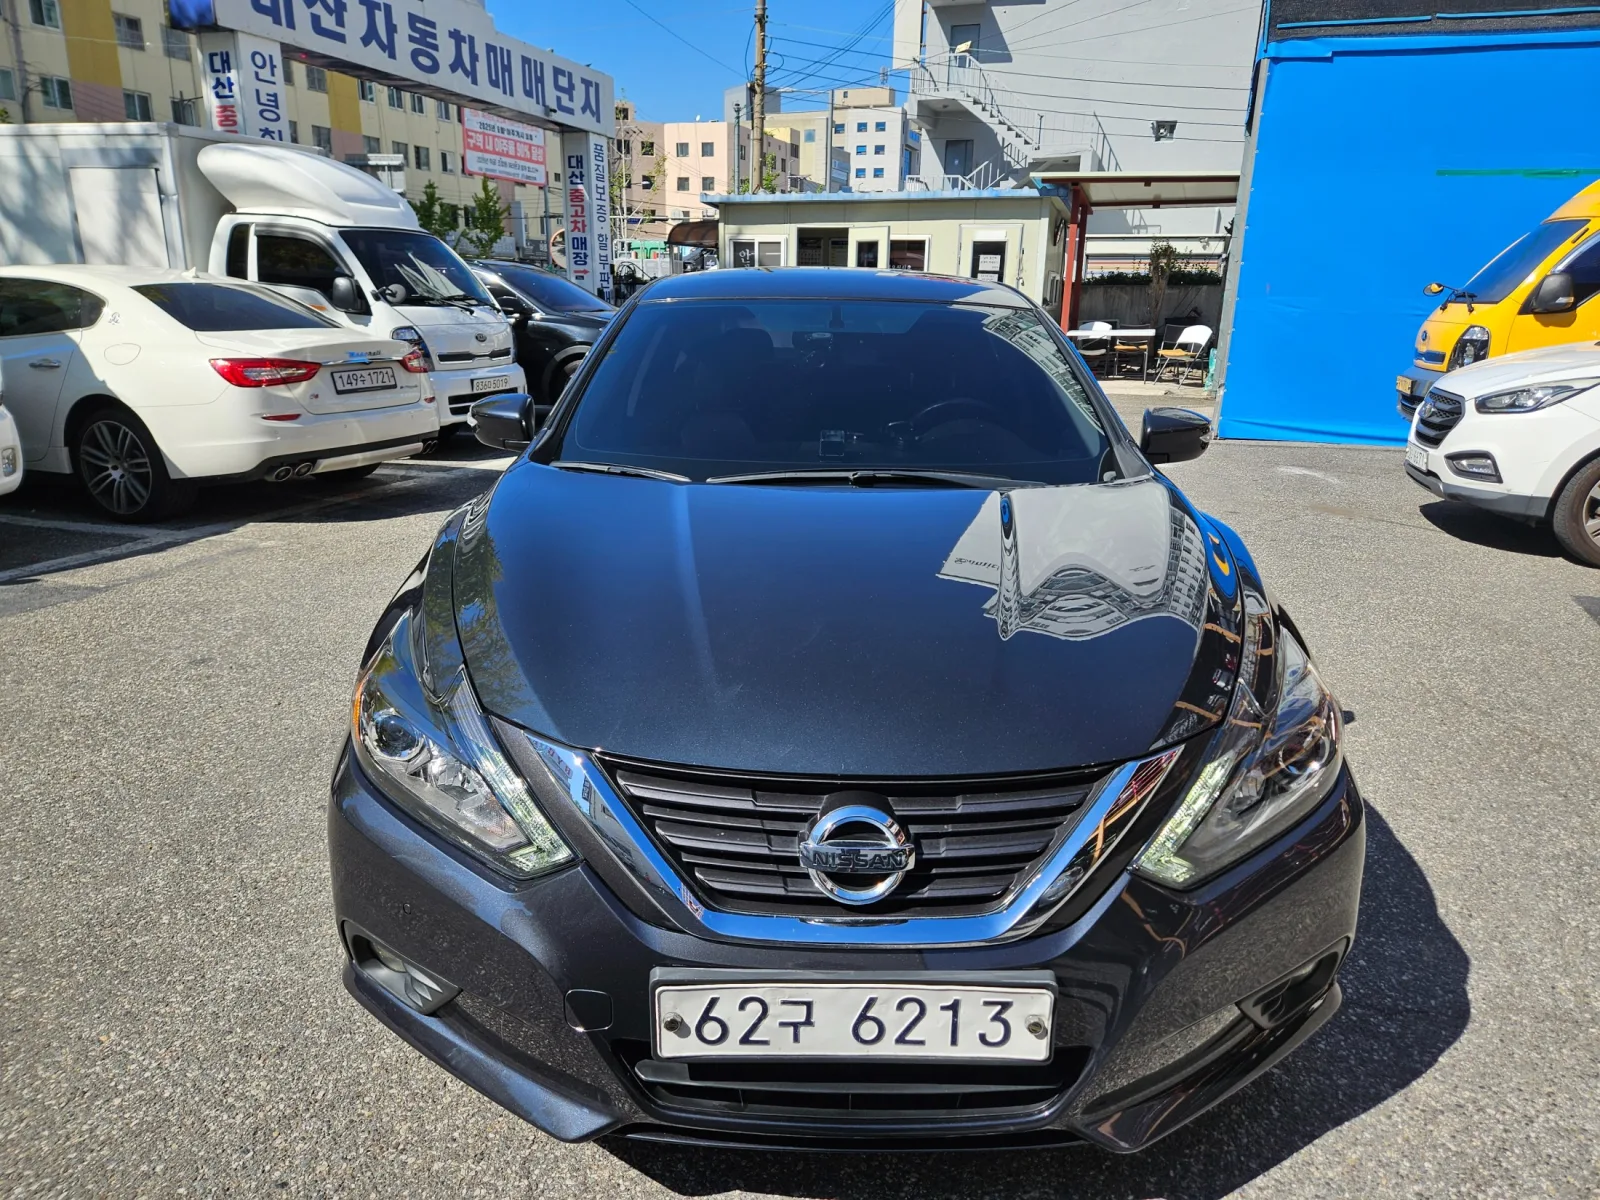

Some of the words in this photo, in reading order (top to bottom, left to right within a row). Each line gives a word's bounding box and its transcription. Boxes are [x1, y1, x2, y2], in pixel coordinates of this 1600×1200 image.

[208, 50, 235, 99] 대산
[215, 104, 239, 134] 중
[467, 131, 484, 150] 구역
[567, 154, 585, 186] 대산
[569, 188, 588, 234] 중고차
[571, 236, 589, 267] 매장
[812, 850, 909, 870] NISSAN
[694, 996, 816, 1047] 62구
[851, 996, 1014, 1048] 6213
